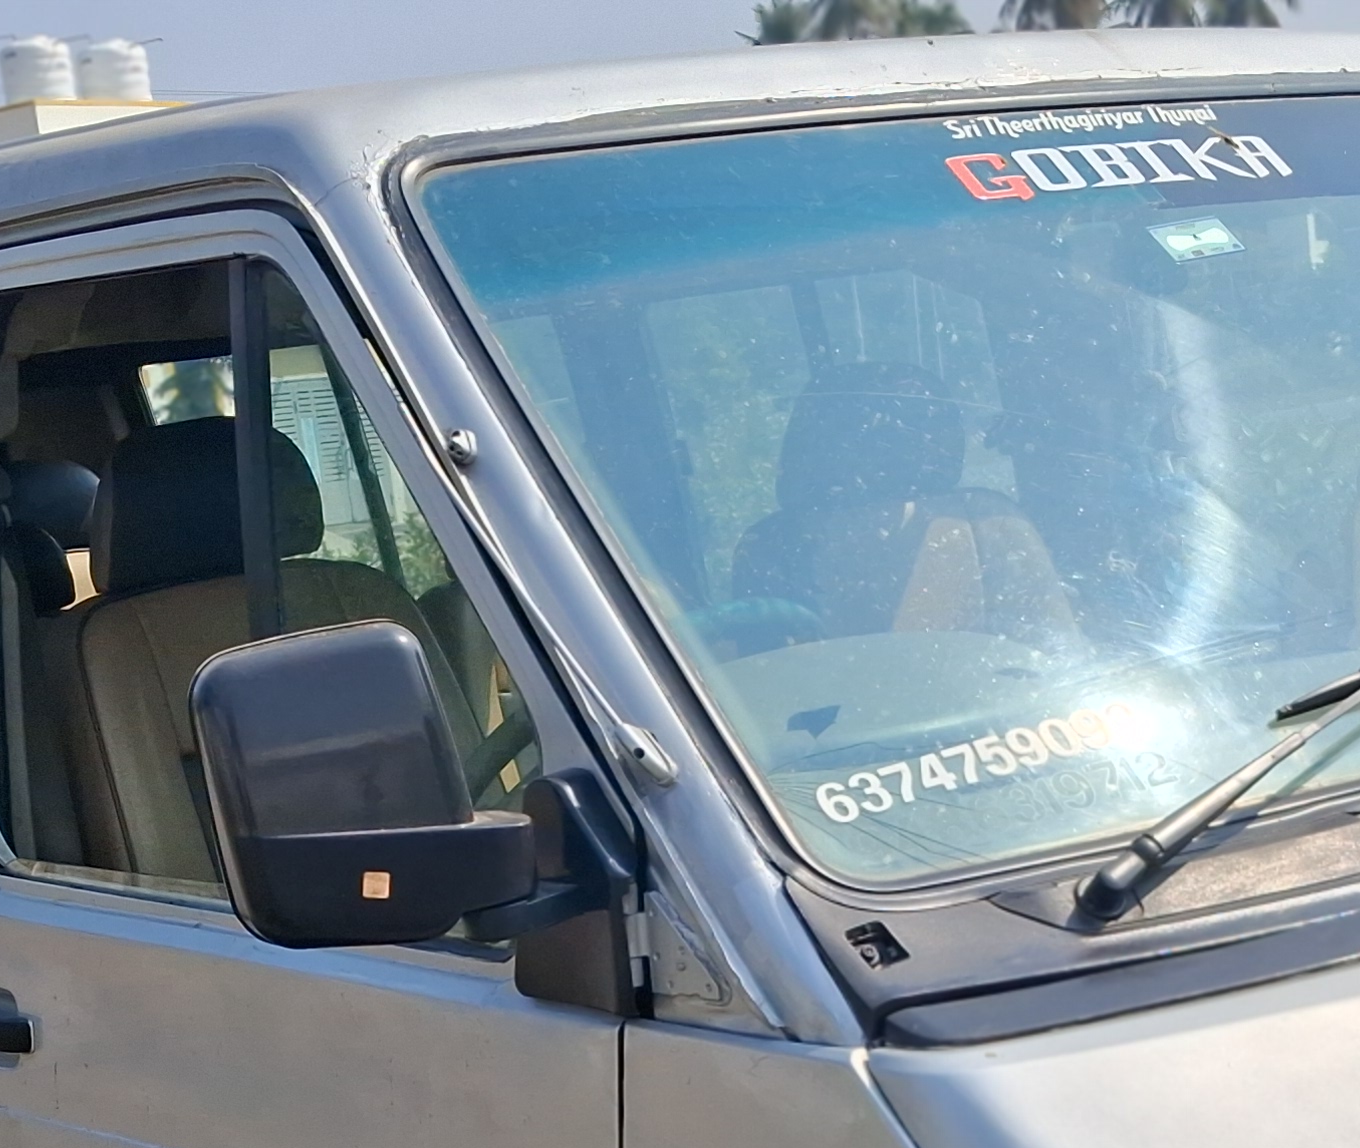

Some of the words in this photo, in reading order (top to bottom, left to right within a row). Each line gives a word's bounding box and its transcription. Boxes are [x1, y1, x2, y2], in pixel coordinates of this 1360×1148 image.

[942, 117, 982, 140] Sri
[975, 108, 1145, 138] Theerthagiriyar
[1141, 104, 1218, 127] Thunai
[944, 135, 1294, 201] GOBIKA
[814, 702, 1133, 824] 637475909
